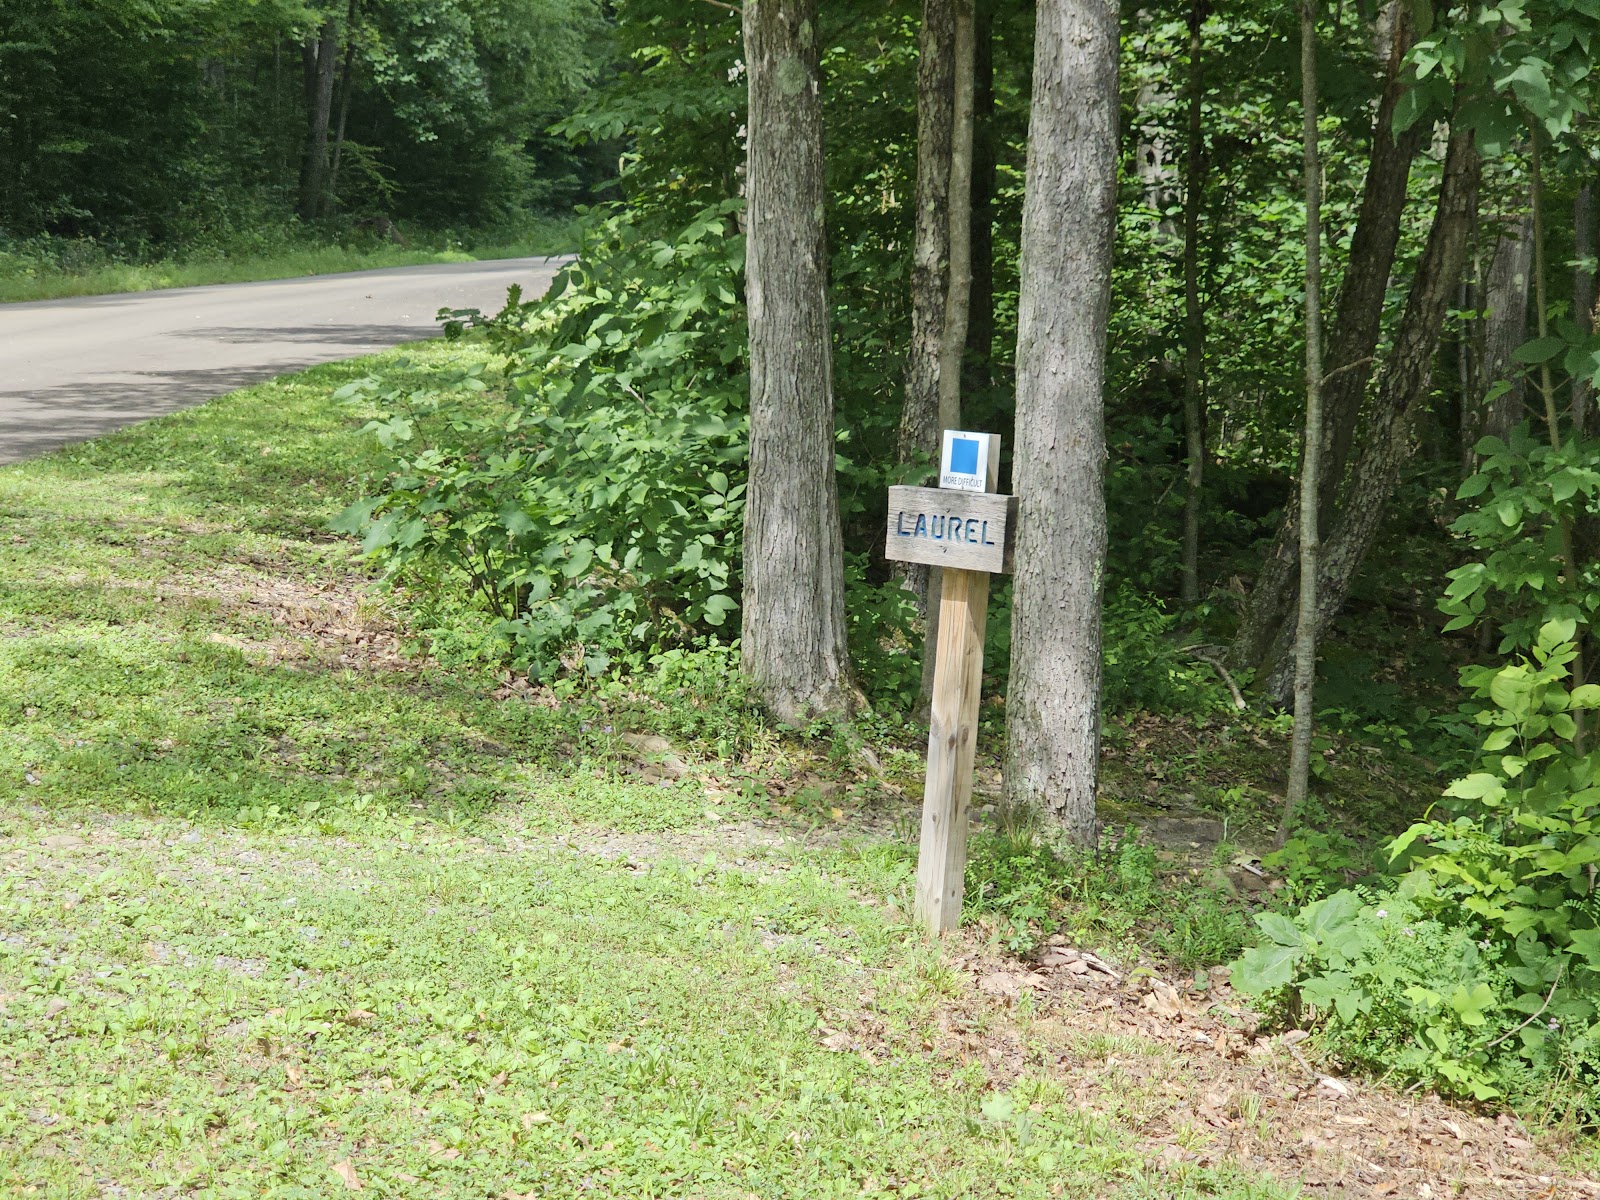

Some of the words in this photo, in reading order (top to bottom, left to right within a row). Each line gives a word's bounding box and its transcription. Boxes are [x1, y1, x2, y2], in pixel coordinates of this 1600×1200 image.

[943, 475, 958, 485] MORE
[958, 477, 983, 488] DIFFICULT
[897, 511, 995, 545] LAUREL
